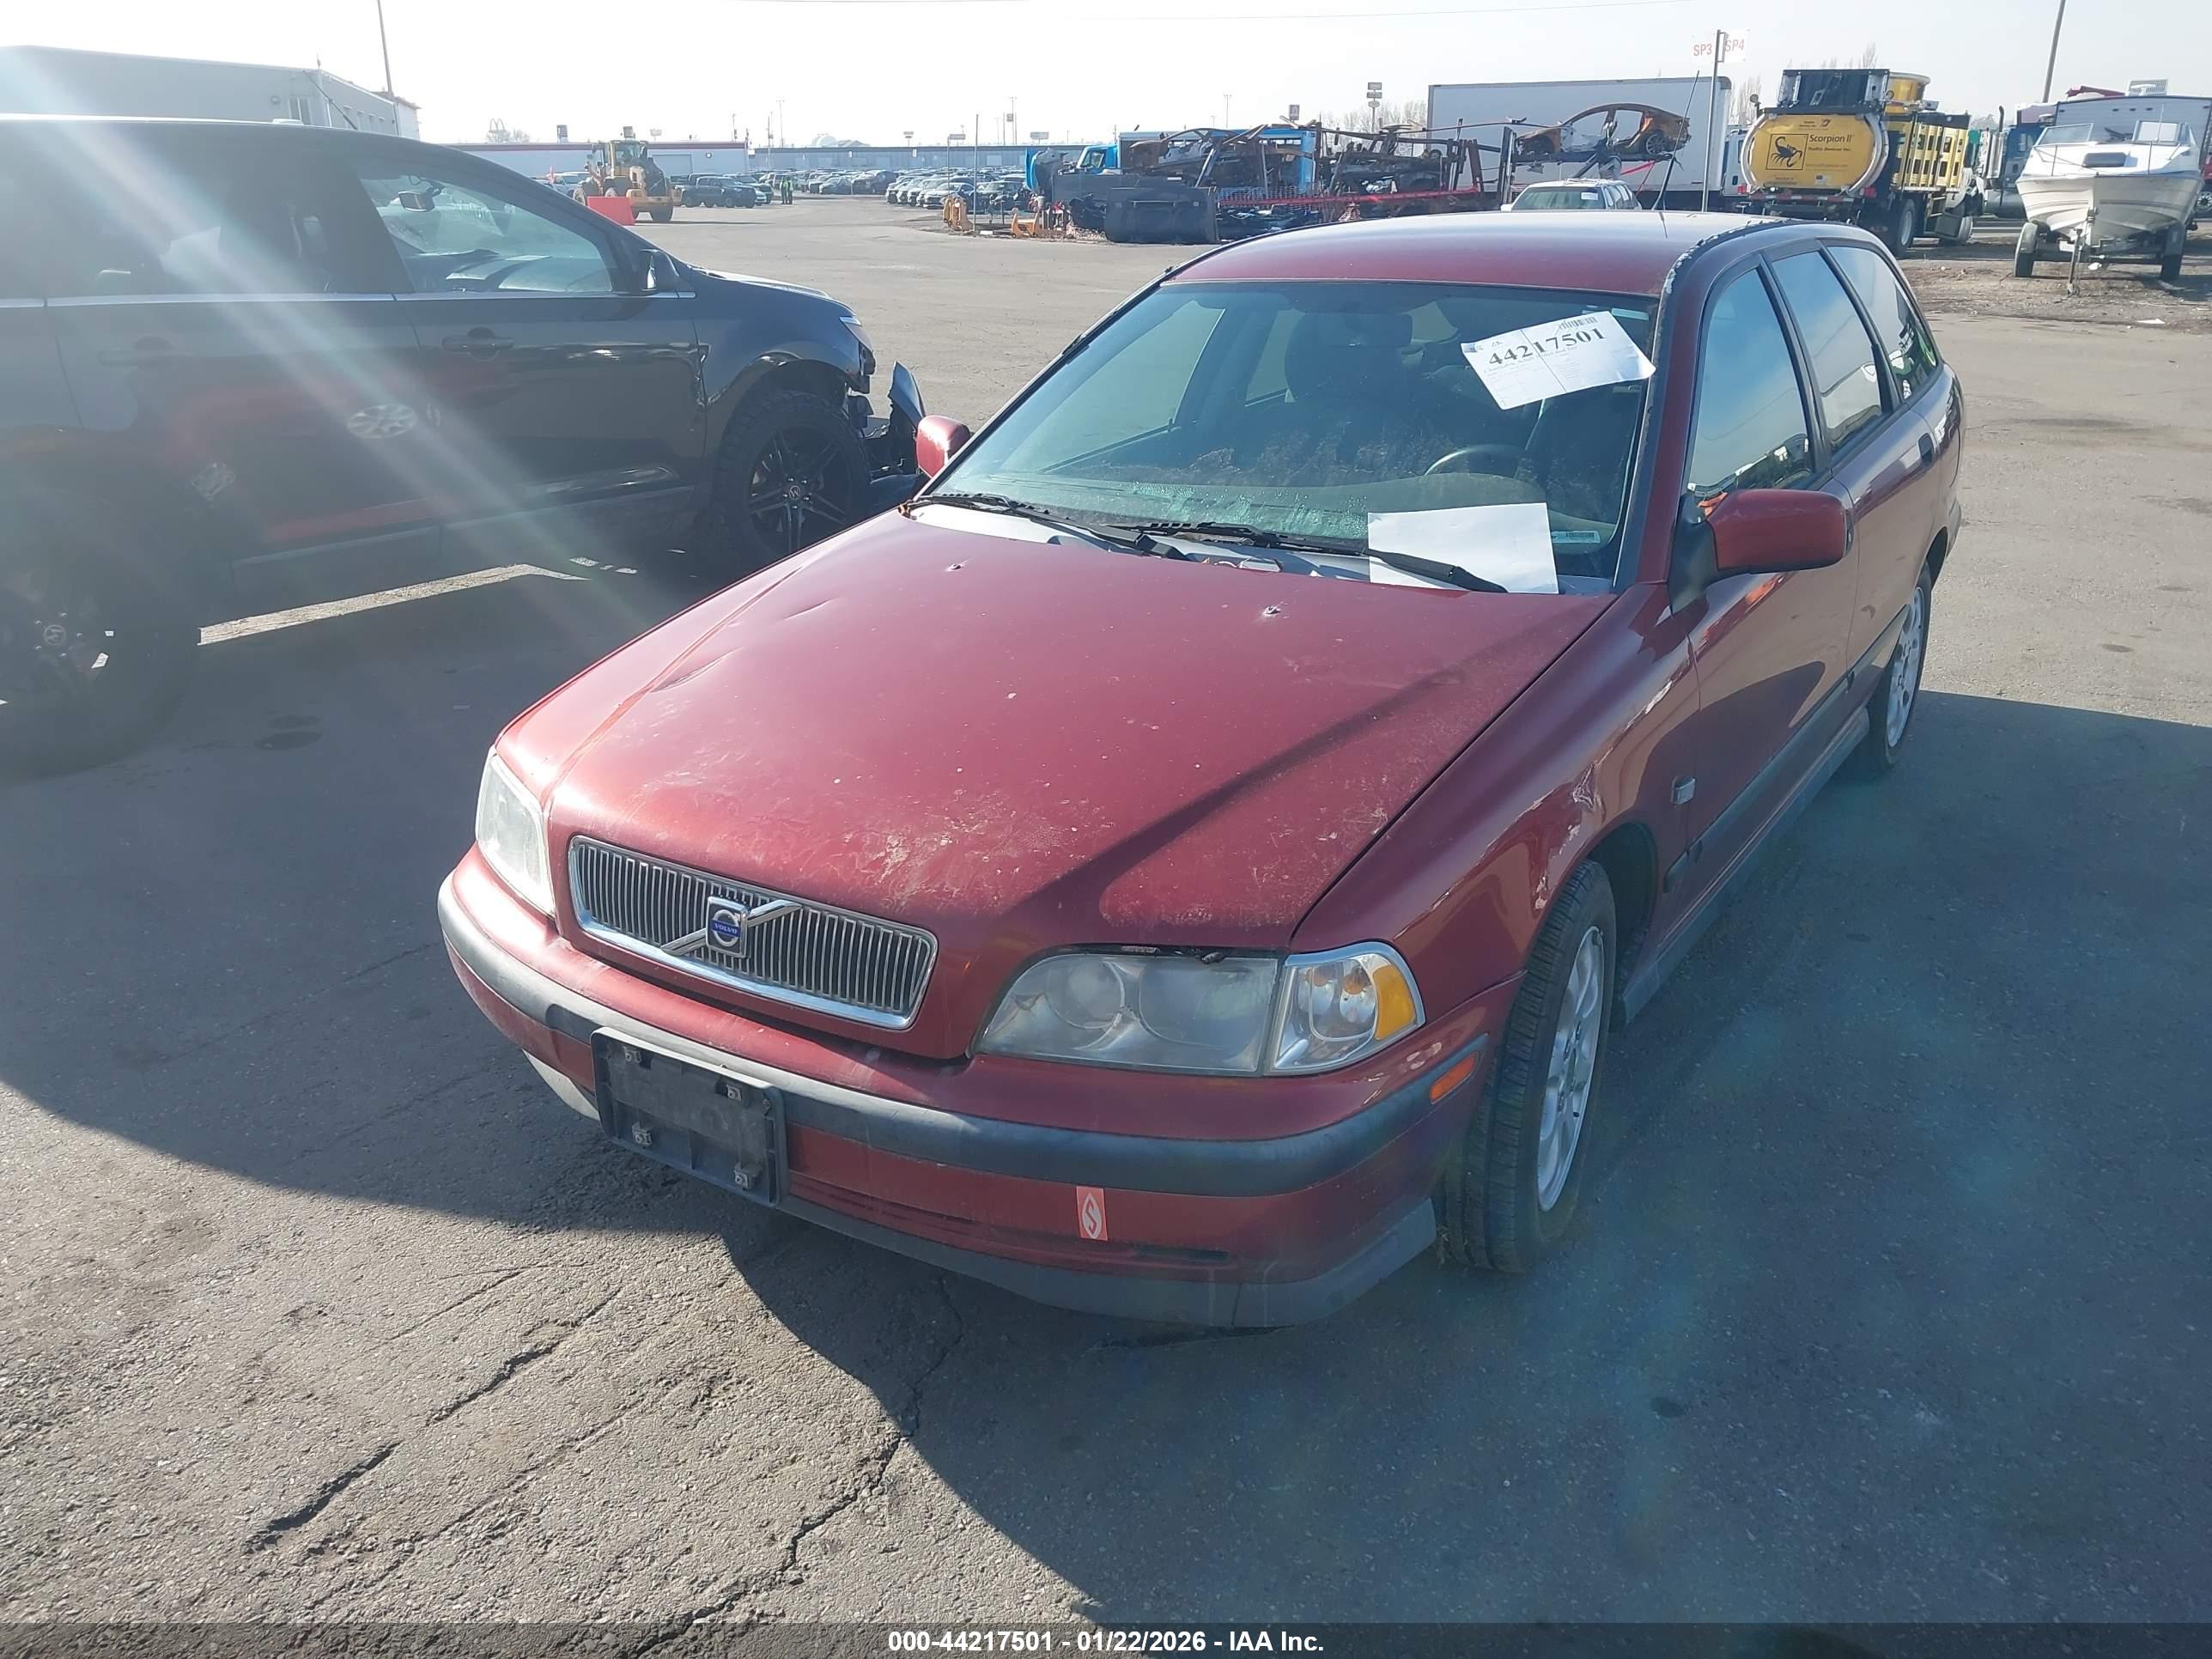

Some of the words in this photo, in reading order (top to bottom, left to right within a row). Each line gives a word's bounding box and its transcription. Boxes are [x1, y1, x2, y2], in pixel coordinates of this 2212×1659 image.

[1693, 43, 1712, 56] SP3
[1725, 39, 1745, 52] SP4
[1808, 134, 1845, 144] Scorpion
[1489, 328, 1607, 365] 44217501
[714, 922, 738, 934] VOLVO
